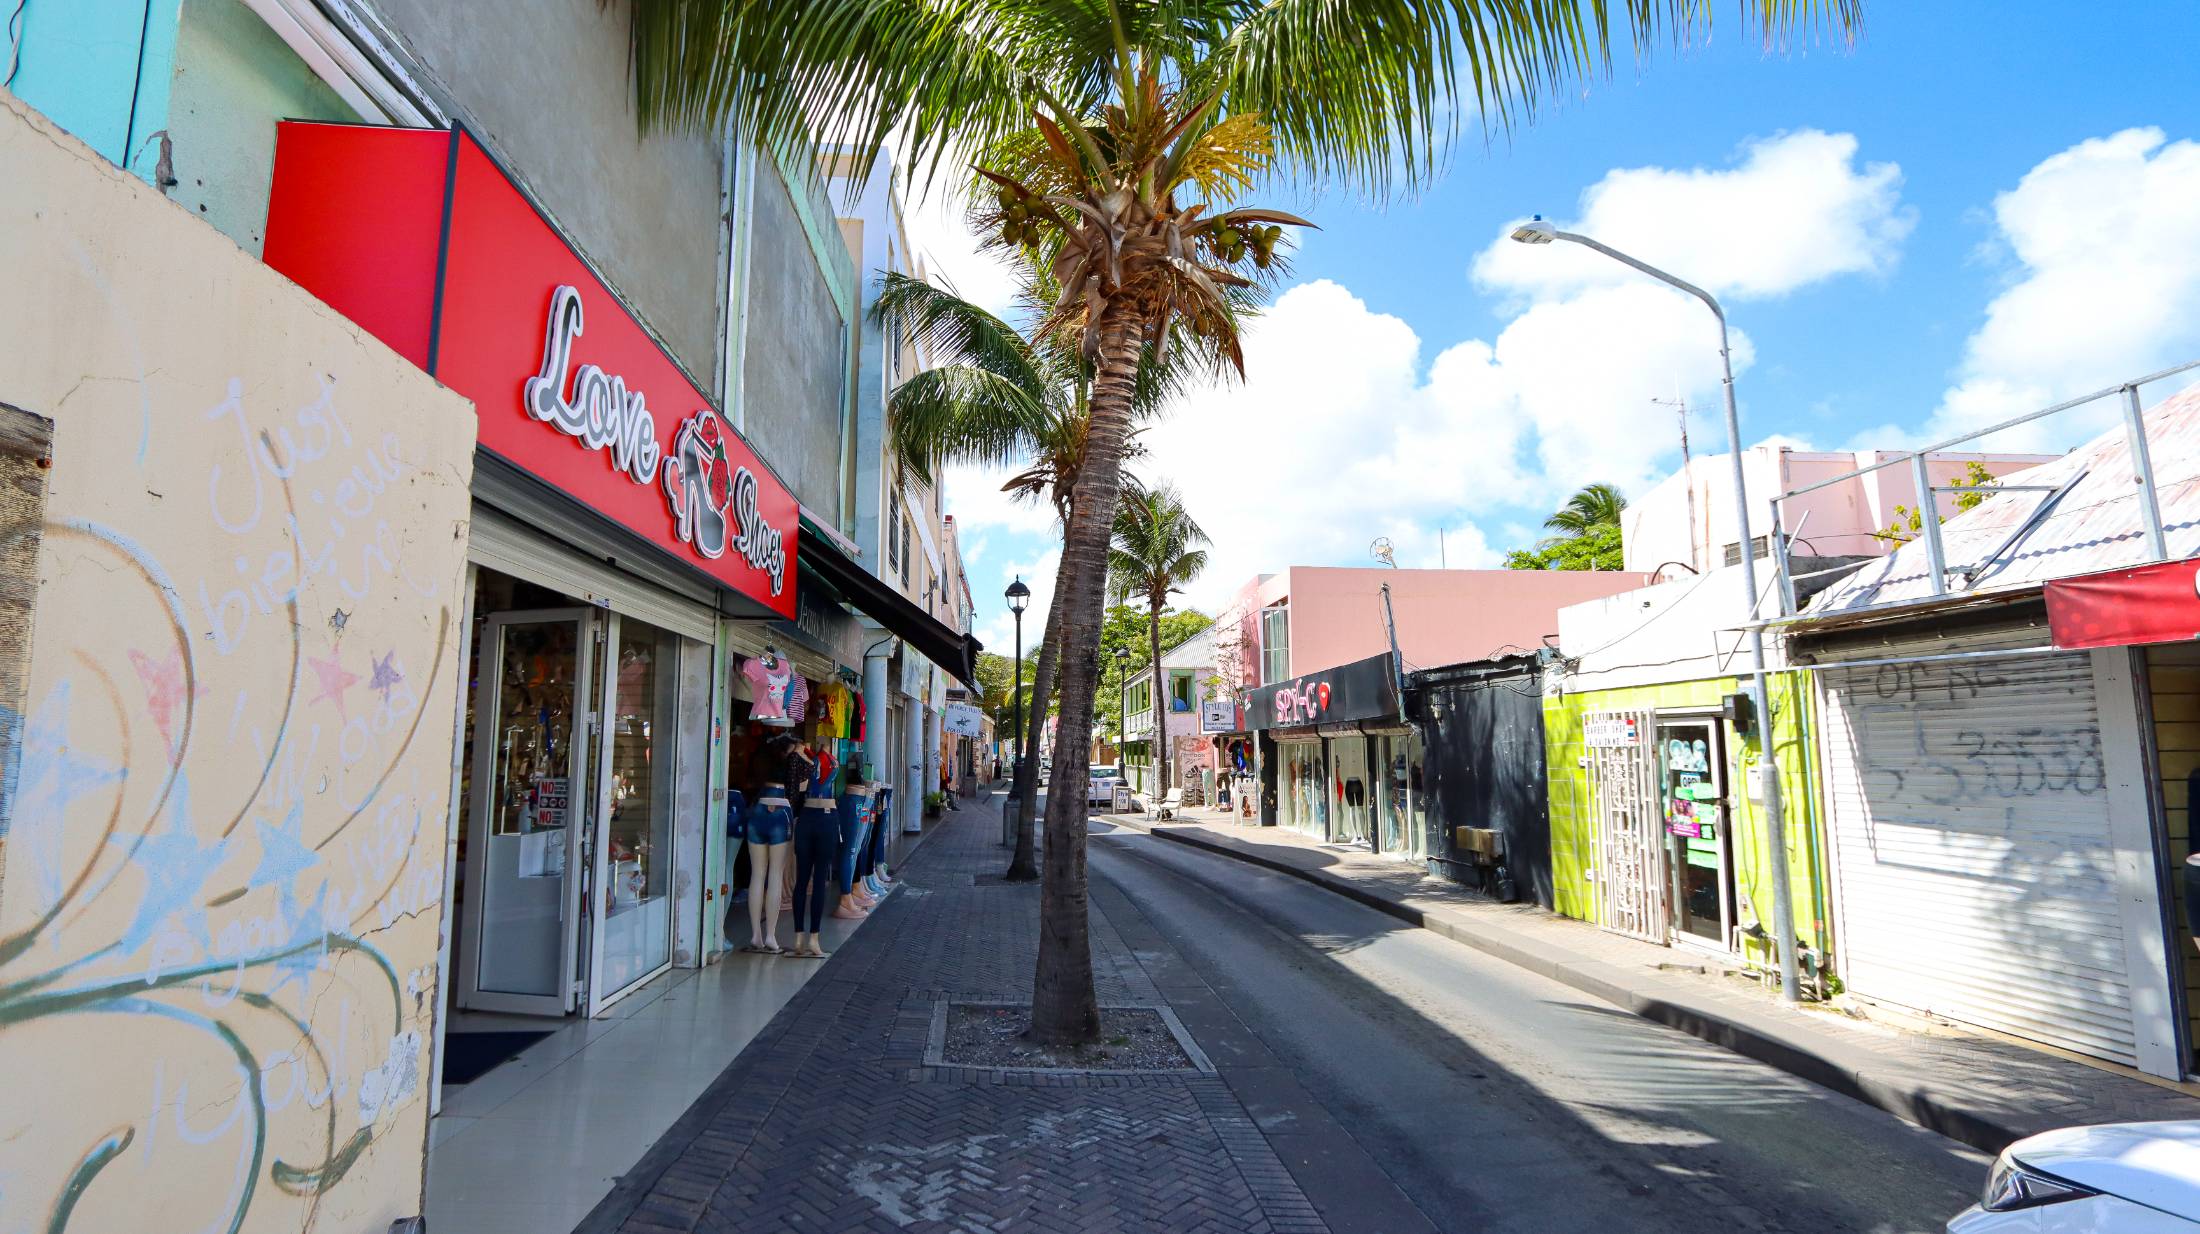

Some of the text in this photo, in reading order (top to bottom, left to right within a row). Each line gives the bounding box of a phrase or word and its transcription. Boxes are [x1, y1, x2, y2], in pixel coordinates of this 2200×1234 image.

[204, 369, 354, 535] Just
[525, 285, 786, 597] Love Shoes
[539, 811, 551, 824] NO
[541, 782, 554, 794] NO
